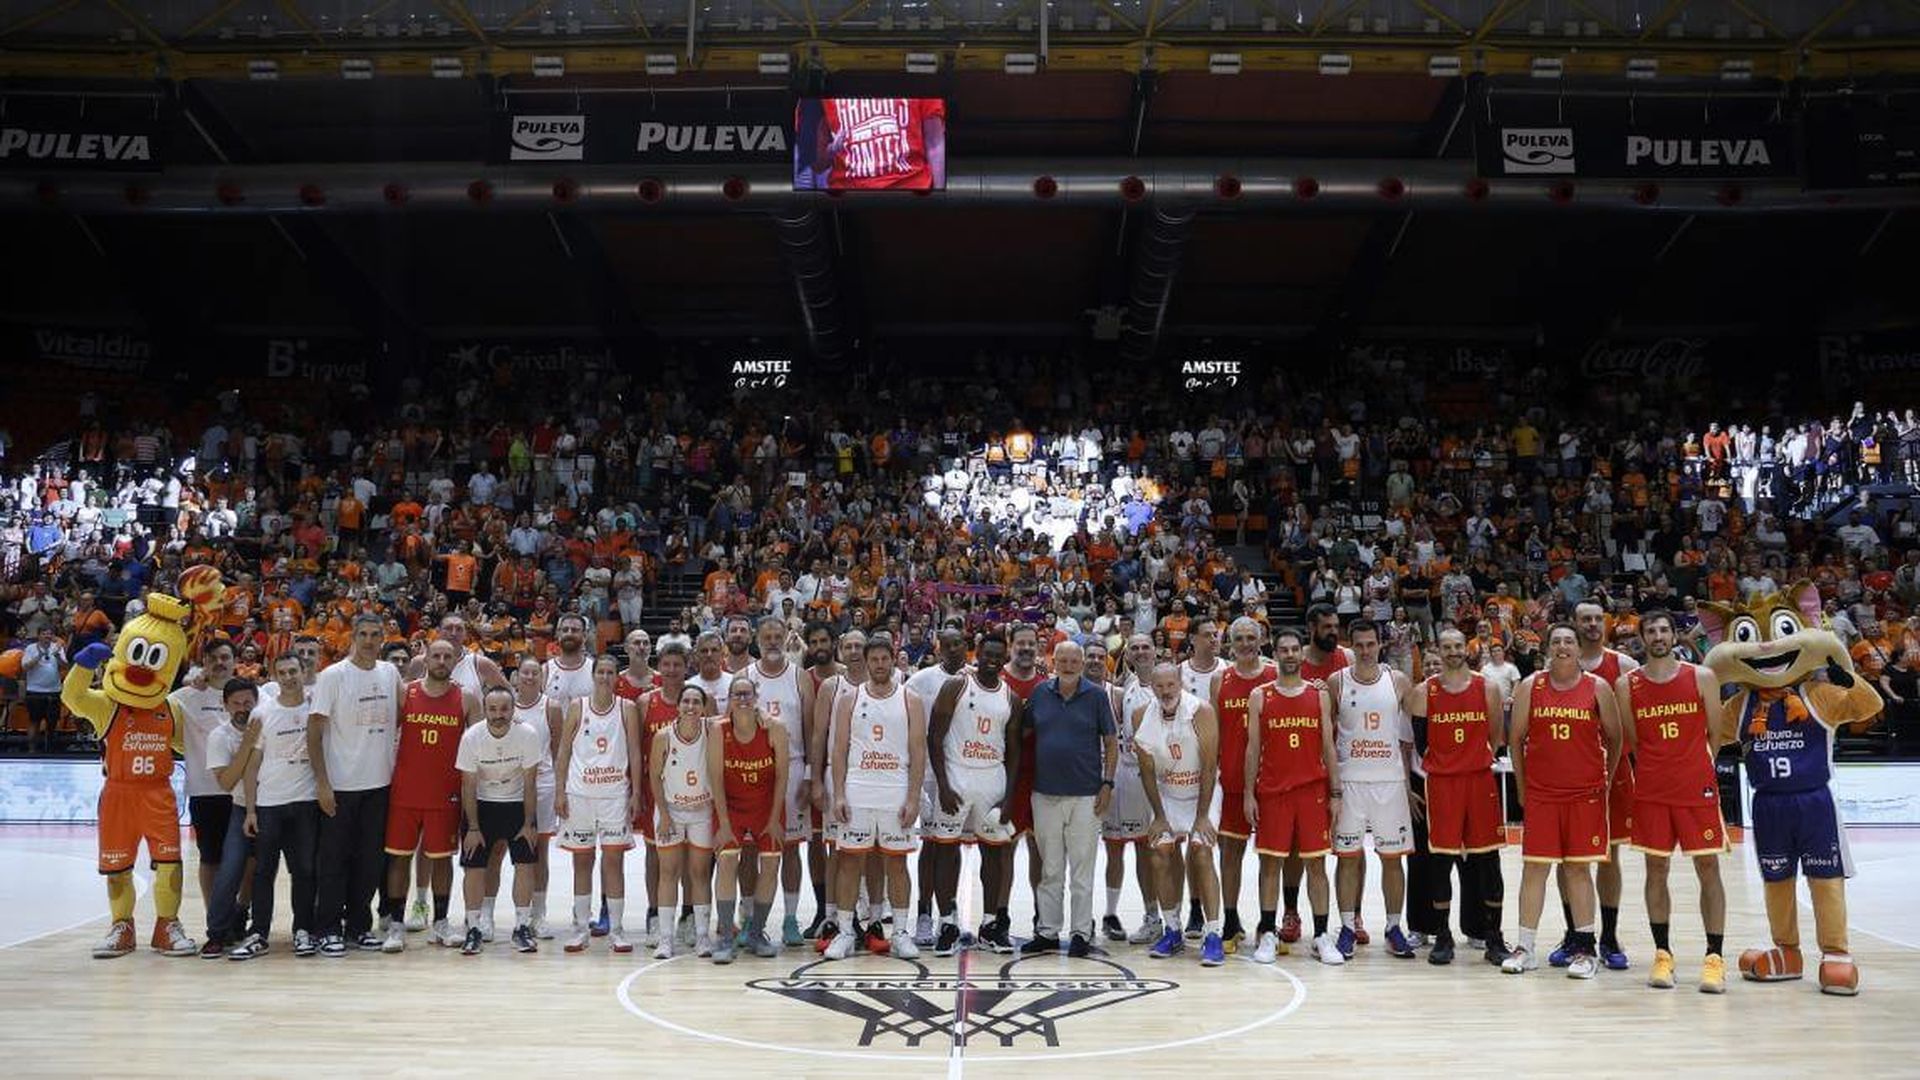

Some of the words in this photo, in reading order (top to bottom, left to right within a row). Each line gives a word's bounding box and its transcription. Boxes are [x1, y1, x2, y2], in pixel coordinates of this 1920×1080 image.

[515, 120, 581, 134] PULEVA
[0, 129, 151, 160] PULEVA
[636, 122, 788, 152] PULEVA
[1506, 134, 1570, 147] PULEVA
[1625, 135, 1772, 165] PULEVA
[35, 330, 149, 358] Vitaldin
[732, 360, 791, 373] AMSTEL
[1181, 361, 1241, 374] AMSTEL
[767, 701, 781, 717] 13
[977, 716, 991, 734] 10
[1364, 712, 1380, 730] 19
[421, 730, 438, 745] 10
[873, 725, 884, 741] 9
[1455, 728, 1464, 743] 8
[1550, 724, 1571, 740] 13
[1659, 722, 1679, 739] 16
[597, 737, 608, 754] 9
[1290, 733, 1299, 748] 8
[1753, 740, 1805, 751] Esfuerzo
[1350, 749, 1392, 758] Esfuerzo
[132, 756, 155, 775] 86
[1769, 757, 1791, 778] 19
[686, 771, 697, 786] 6
[778, 980, 979, 991] VALENCIA
[997, 981, 1151, 991] BASKET
